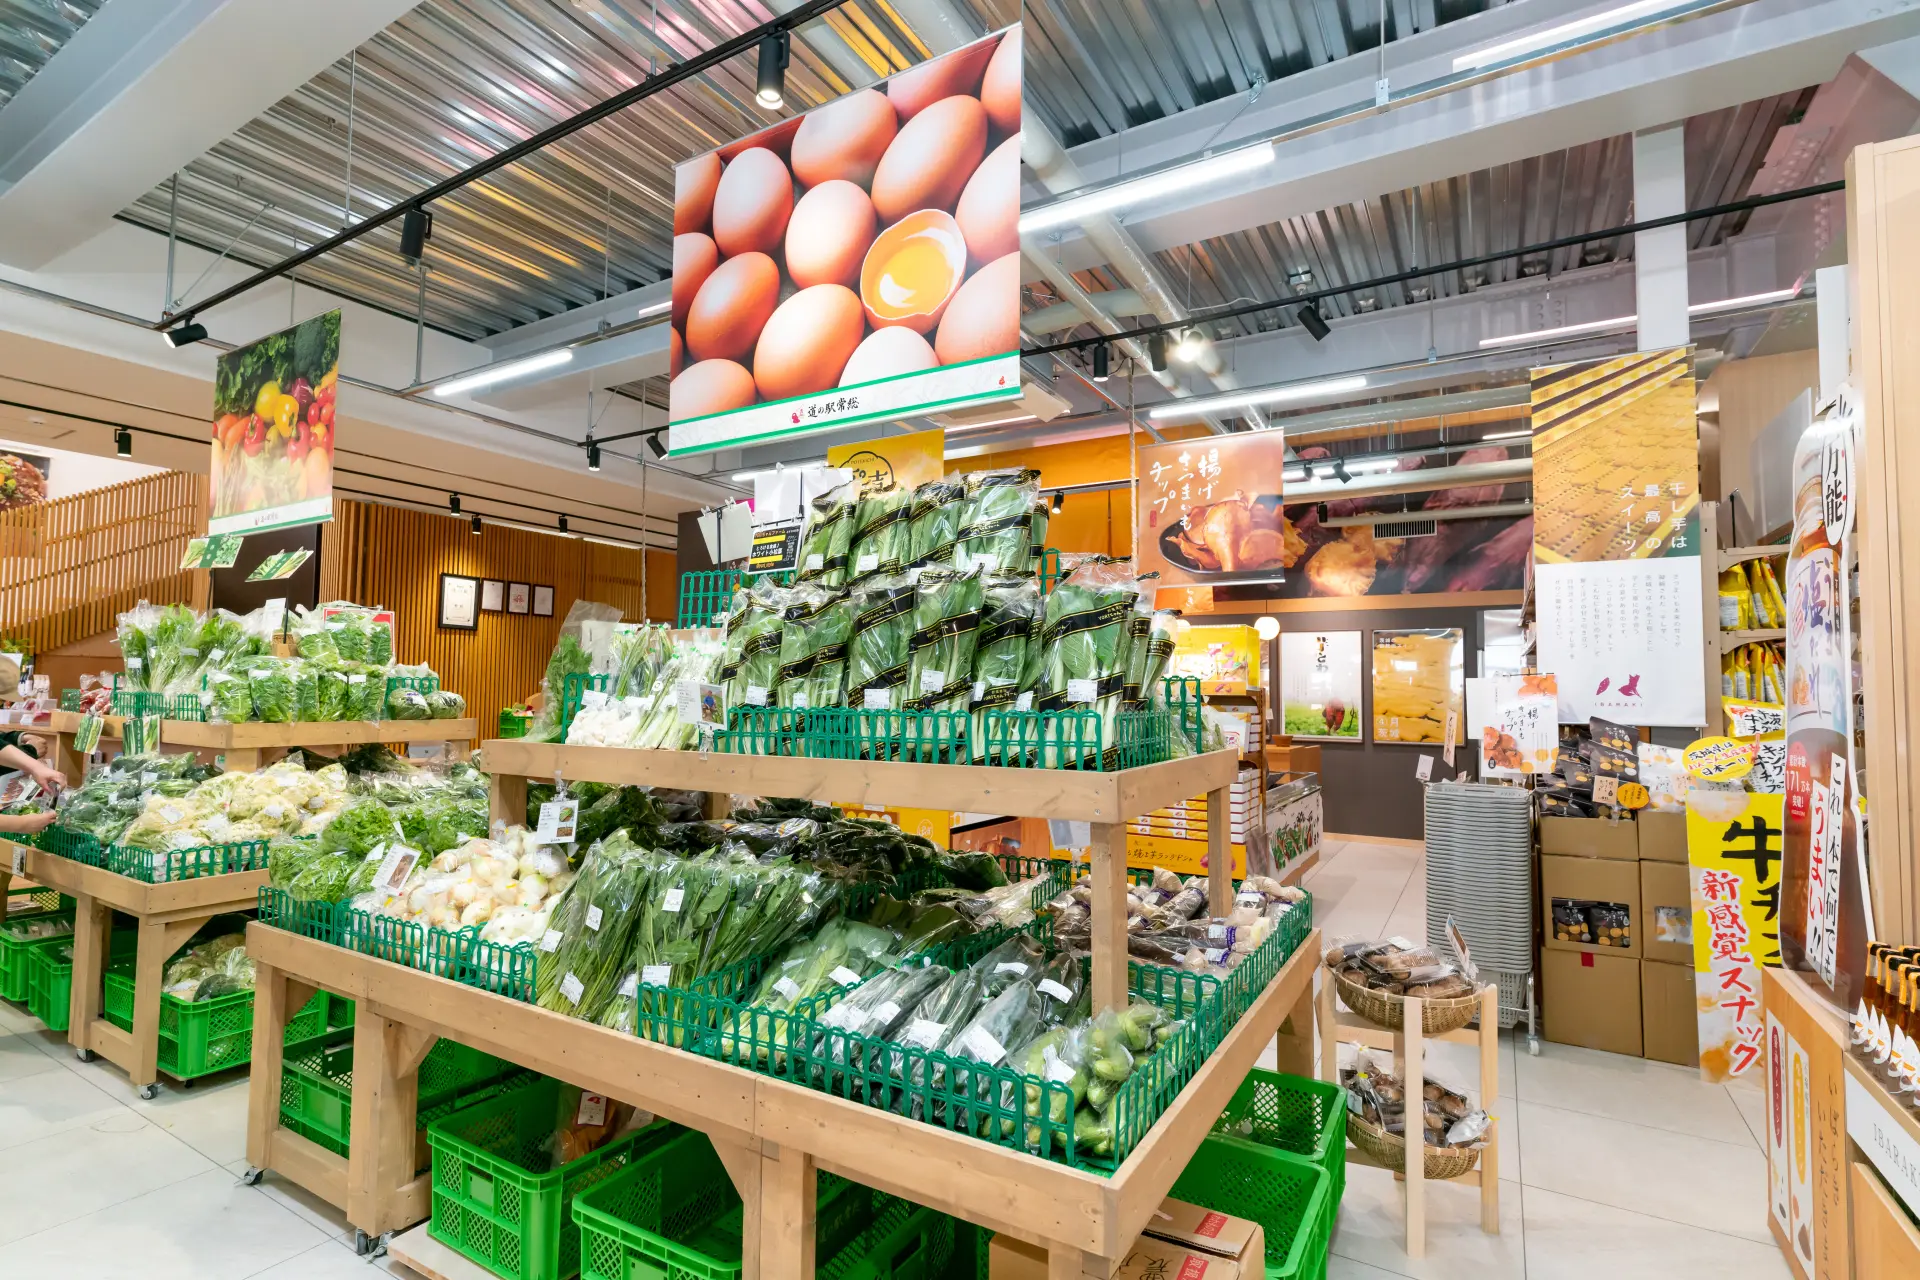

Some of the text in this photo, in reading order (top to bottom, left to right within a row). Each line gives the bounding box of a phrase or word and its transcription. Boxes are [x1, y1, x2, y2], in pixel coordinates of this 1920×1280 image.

[808, 397, 860, 418] 道の駅常総
[1149, 461, 1176, 514] チップ
[1177, 451, 1194, 531] さつまいも
[1197, 447, 1222, 500] 揚げ
[1620, 487, 1637, 559] スイーツ。
[1644, 484, 1662, 549] 最高の
[1669, 481, 1688, 549] 干し芋は
[1701, 870, 1764, 1077] 新感覚スナック
[1873, 1122, 1920, 1193] IBARAK
